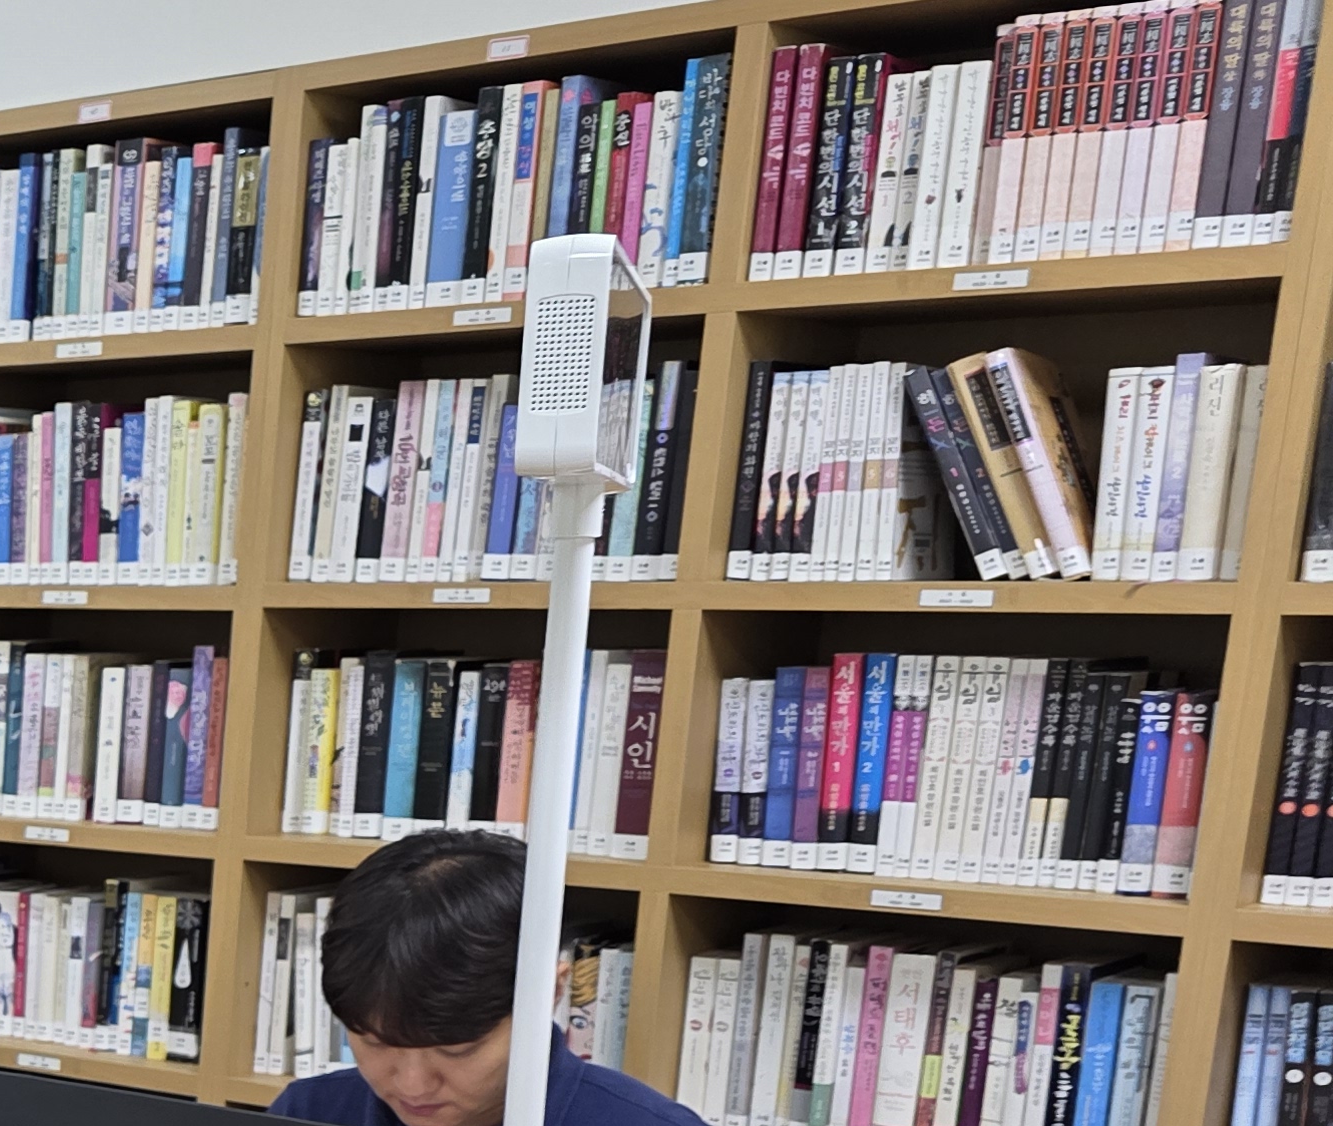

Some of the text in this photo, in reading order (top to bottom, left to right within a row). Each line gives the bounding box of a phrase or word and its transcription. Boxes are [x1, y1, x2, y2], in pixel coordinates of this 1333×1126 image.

[844, 220, 858, 236] 2
[627, 711, 658, 770] 시인
[861, 761, 873, 773] 2
[888, 981, 922, 1056] 서태후
